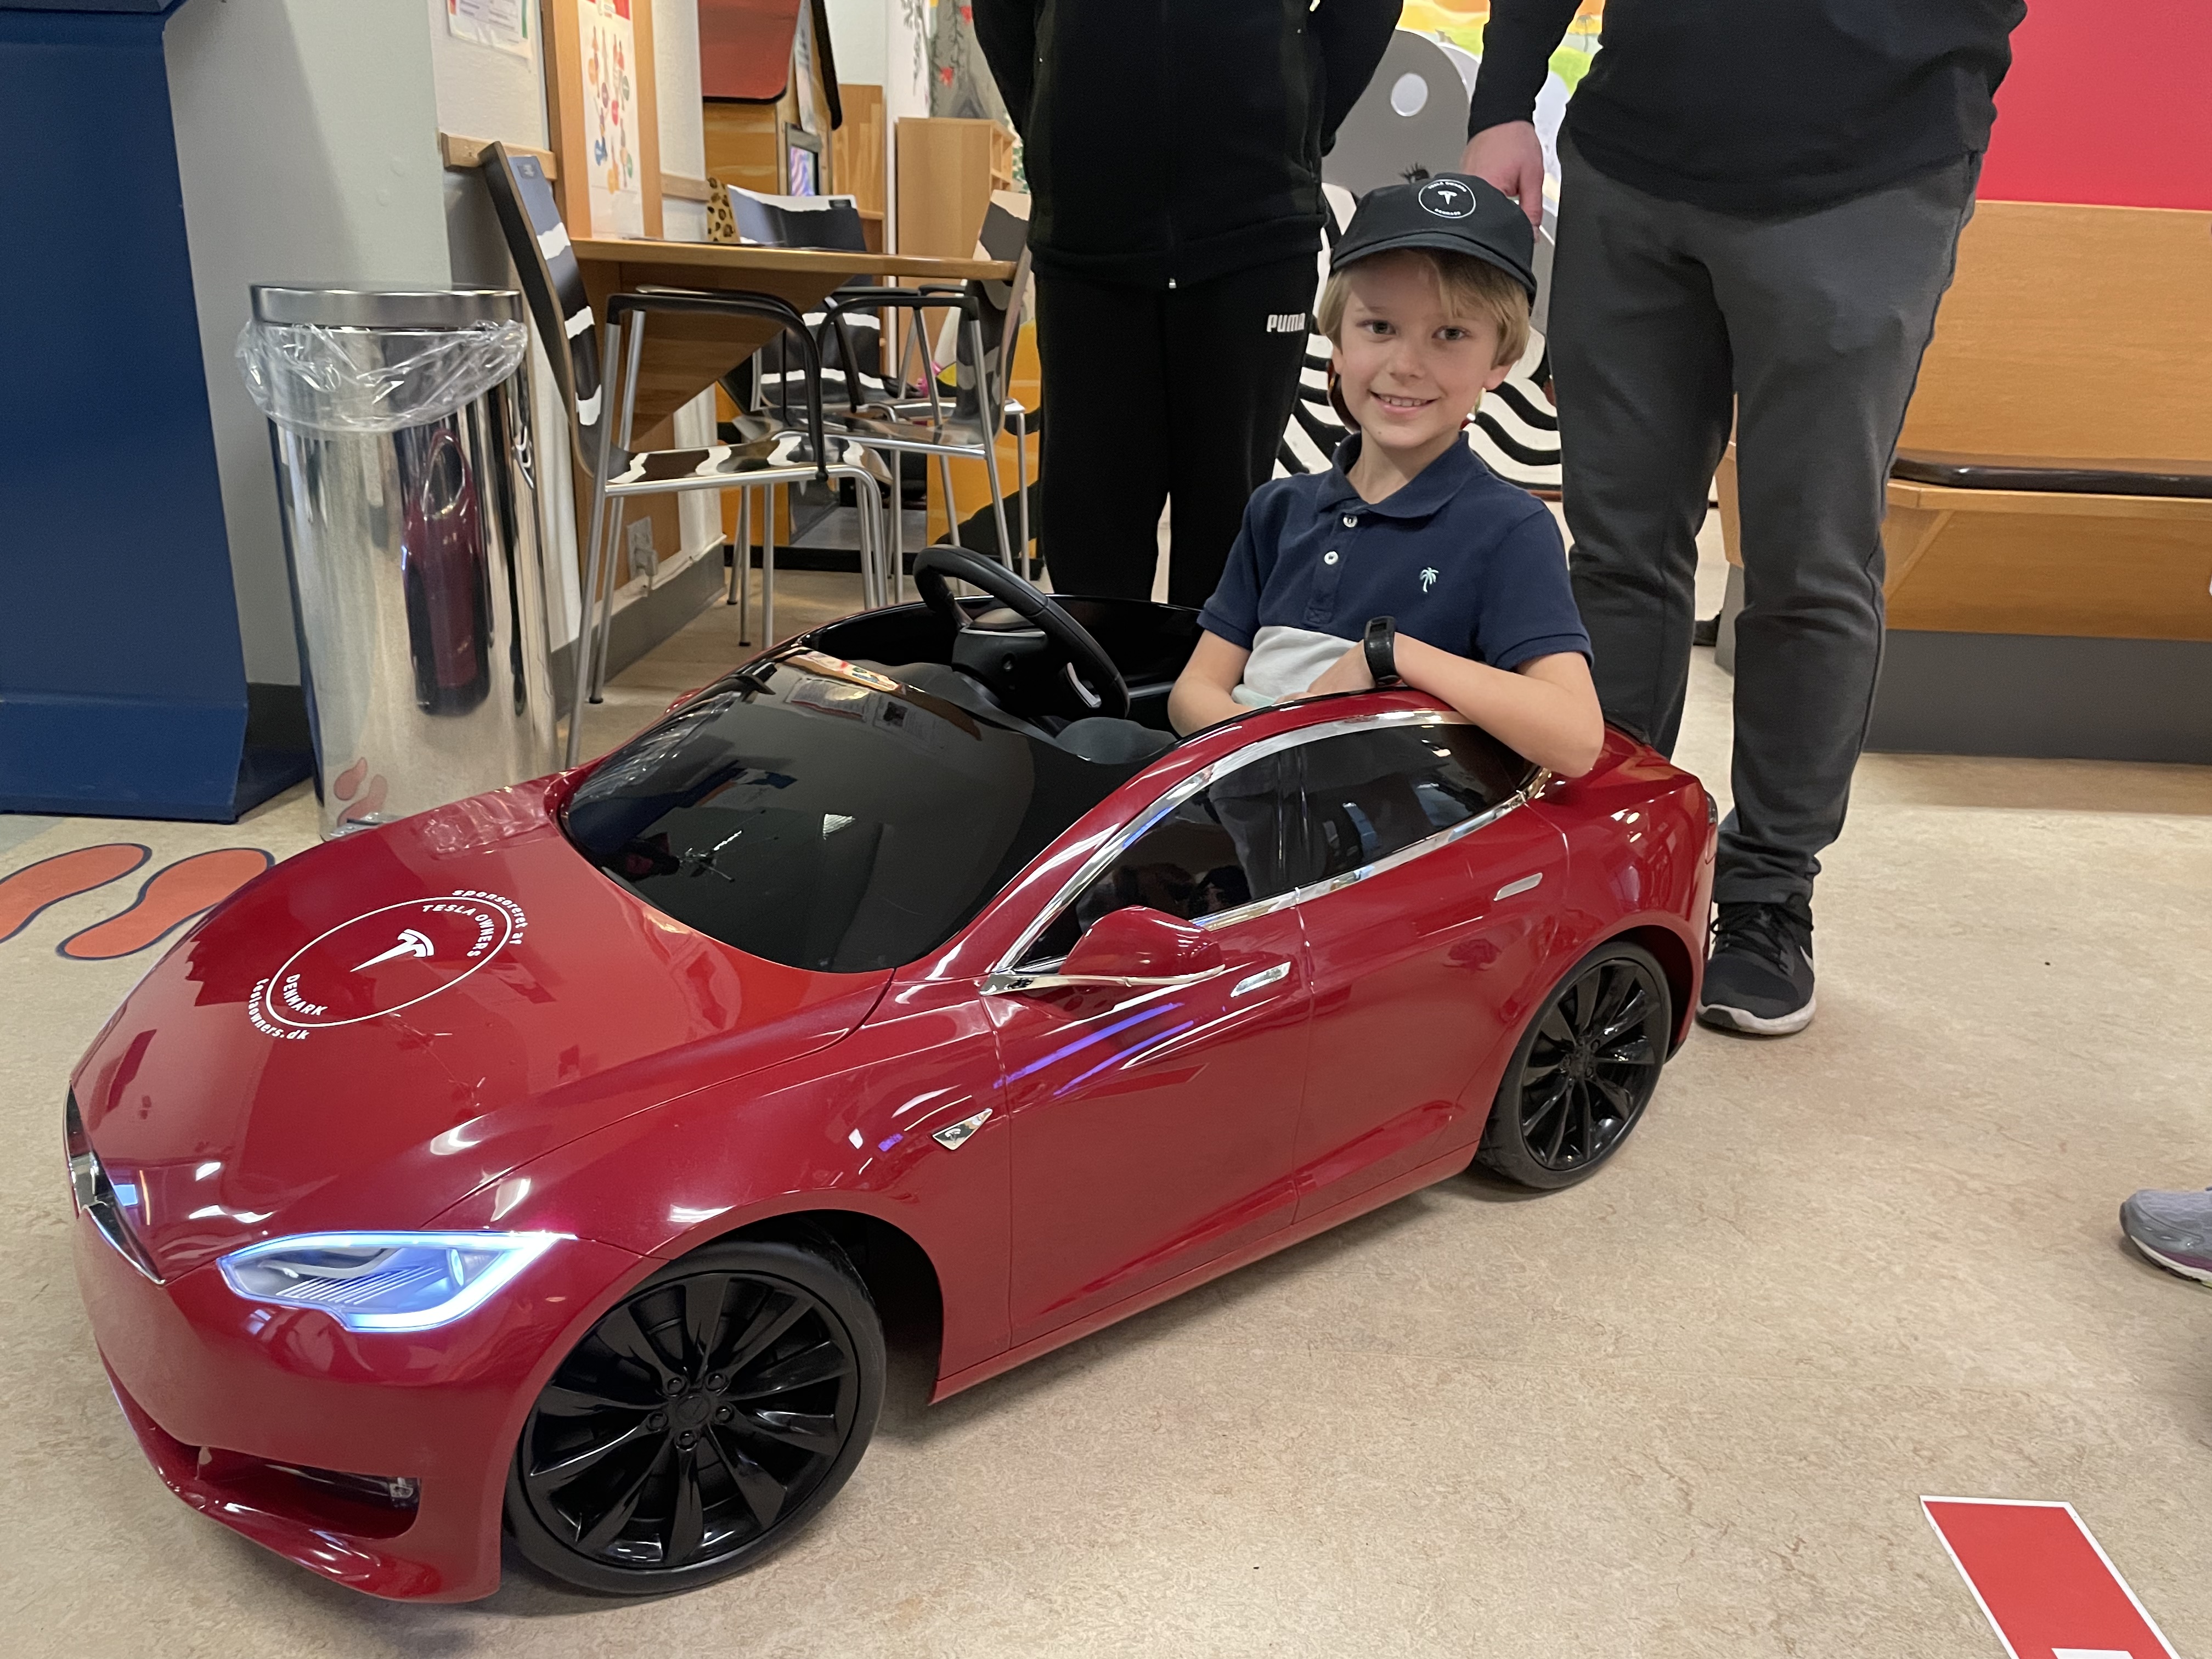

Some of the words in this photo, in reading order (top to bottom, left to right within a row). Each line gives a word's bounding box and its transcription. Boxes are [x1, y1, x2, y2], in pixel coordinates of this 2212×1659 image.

[1266, 313, 1306, 332] PUMA
[452, 889, 528, 929] sponsoreret
[422, 904, 476, 916] TESLA
[466, 914, 495, 957] OWNERS
[249, 978, 309, 1040] teslaowners.dk
[283, 974, 328, 1016] DENMARK
